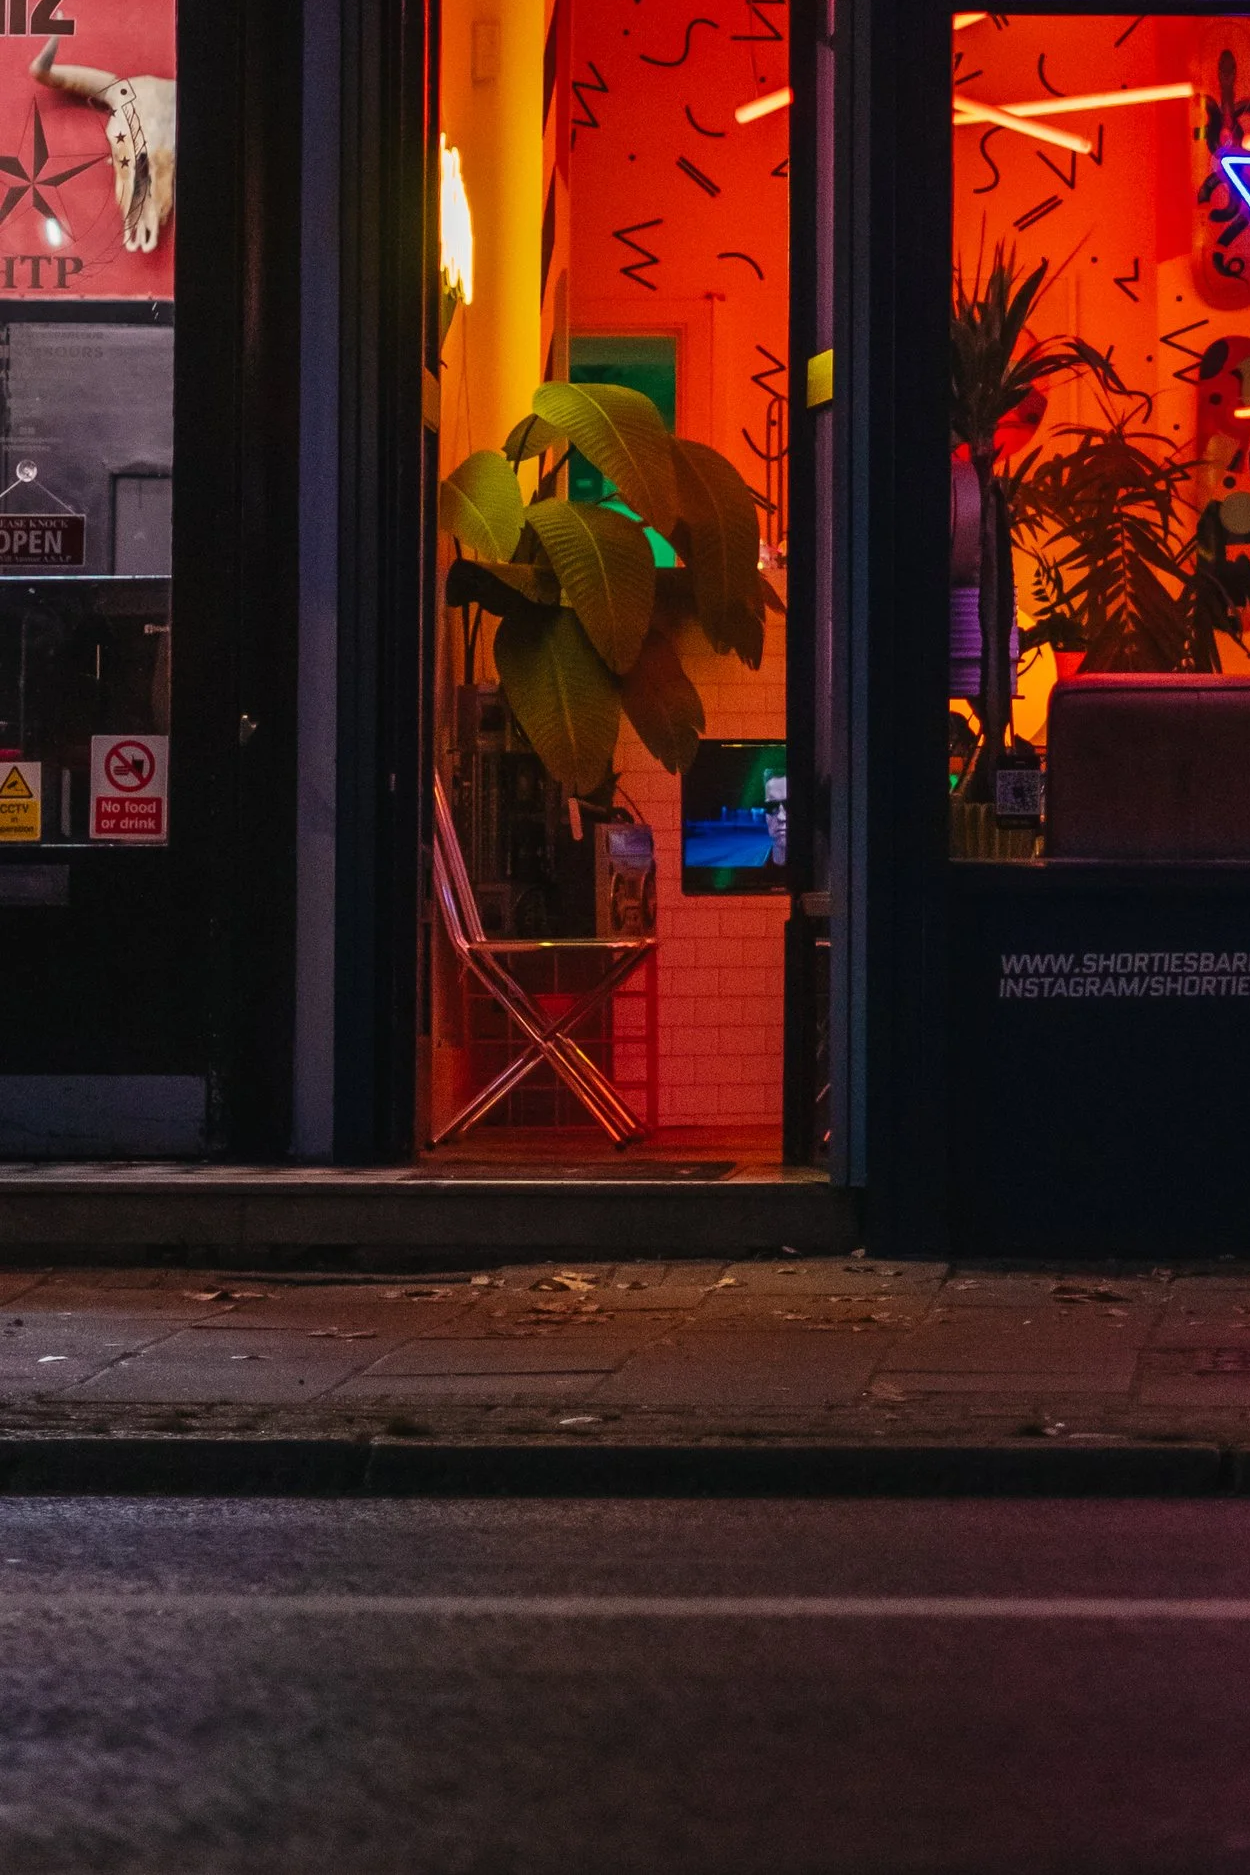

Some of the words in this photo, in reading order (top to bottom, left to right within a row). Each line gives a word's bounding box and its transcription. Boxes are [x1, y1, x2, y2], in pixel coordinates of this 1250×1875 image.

[29, 519, 68, 529] KNOCK
[0, 529, 63, 554] OPEN
[0, 804, 29, 814] CCTV
[101, 801, 121, 814] No
[125, 800, 157, 814] food
[101, 819, 115, 830] or
[119, 817, 157, 830] drink
